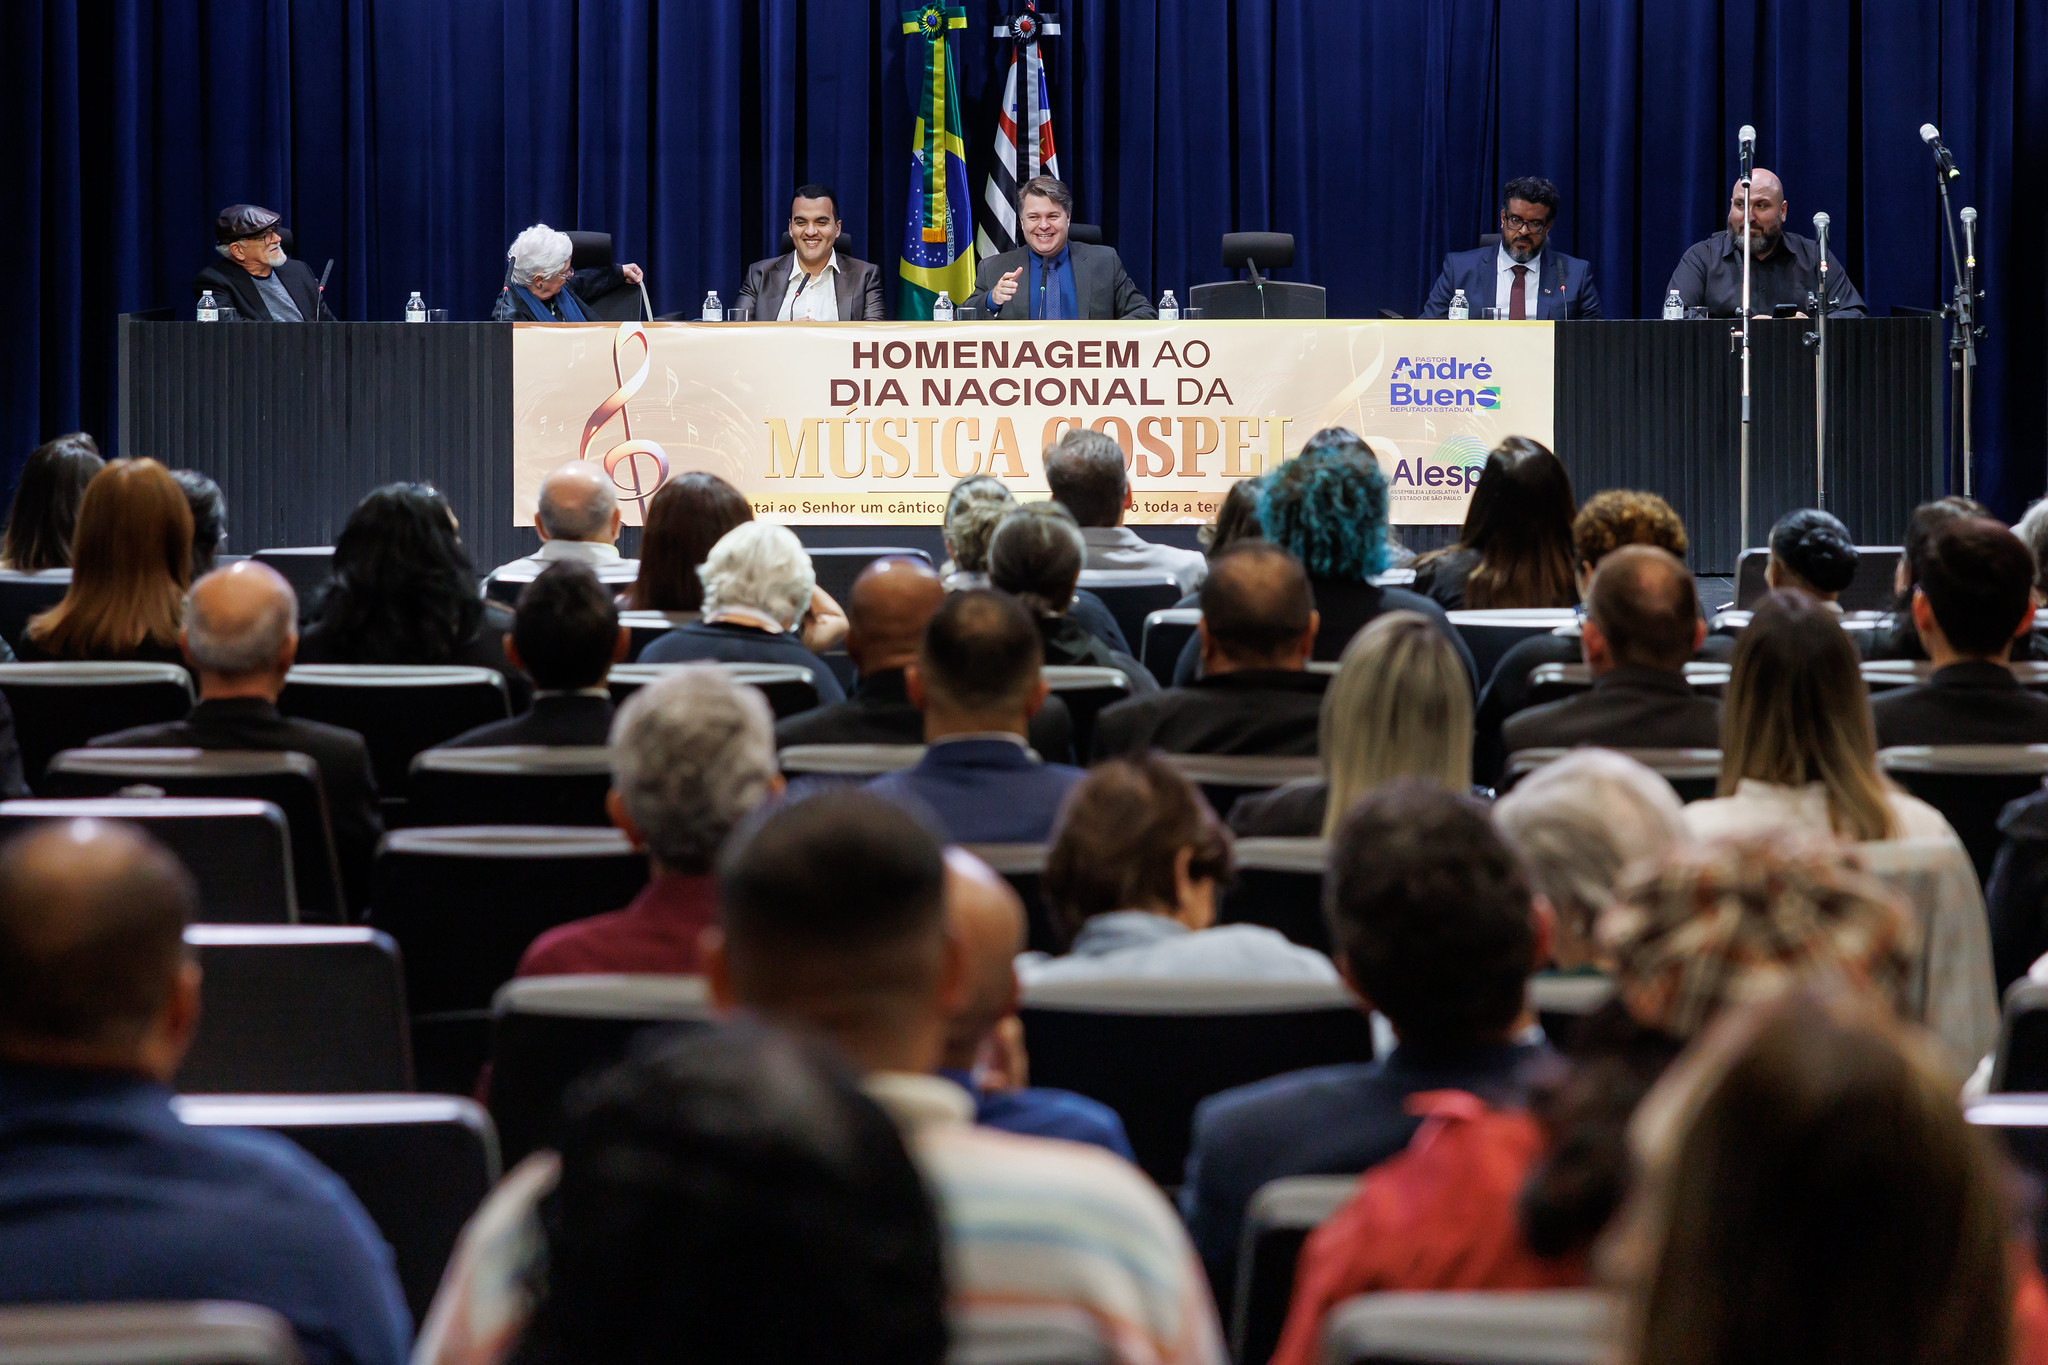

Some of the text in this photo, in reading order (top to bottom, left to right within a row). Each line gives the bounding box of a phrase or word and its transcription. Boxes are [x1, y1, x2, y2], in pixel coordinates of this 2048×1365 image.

[852, 339, 1211, 370] HOMENAGEM AO
[1390, 356, 1493, 380] André
[830, 377, 1234, 407] DIA NACIONAL DA
[1390, 383, 1499, 408] Bueno
[764, 404, 1029, 479] MÚSICA
[1390, 456, 1485, 494] Alesp
[778, 504, 797, 514] ao
[802, 501, 855, 514] Senhor
[860, 504, 883, 514] um
[888, 500, 945, 514] cântico
[1144, 500, 1179, 513] toda
[1183, 503, 1192, 513] a
[1197, 501, 1221, 513] ter
